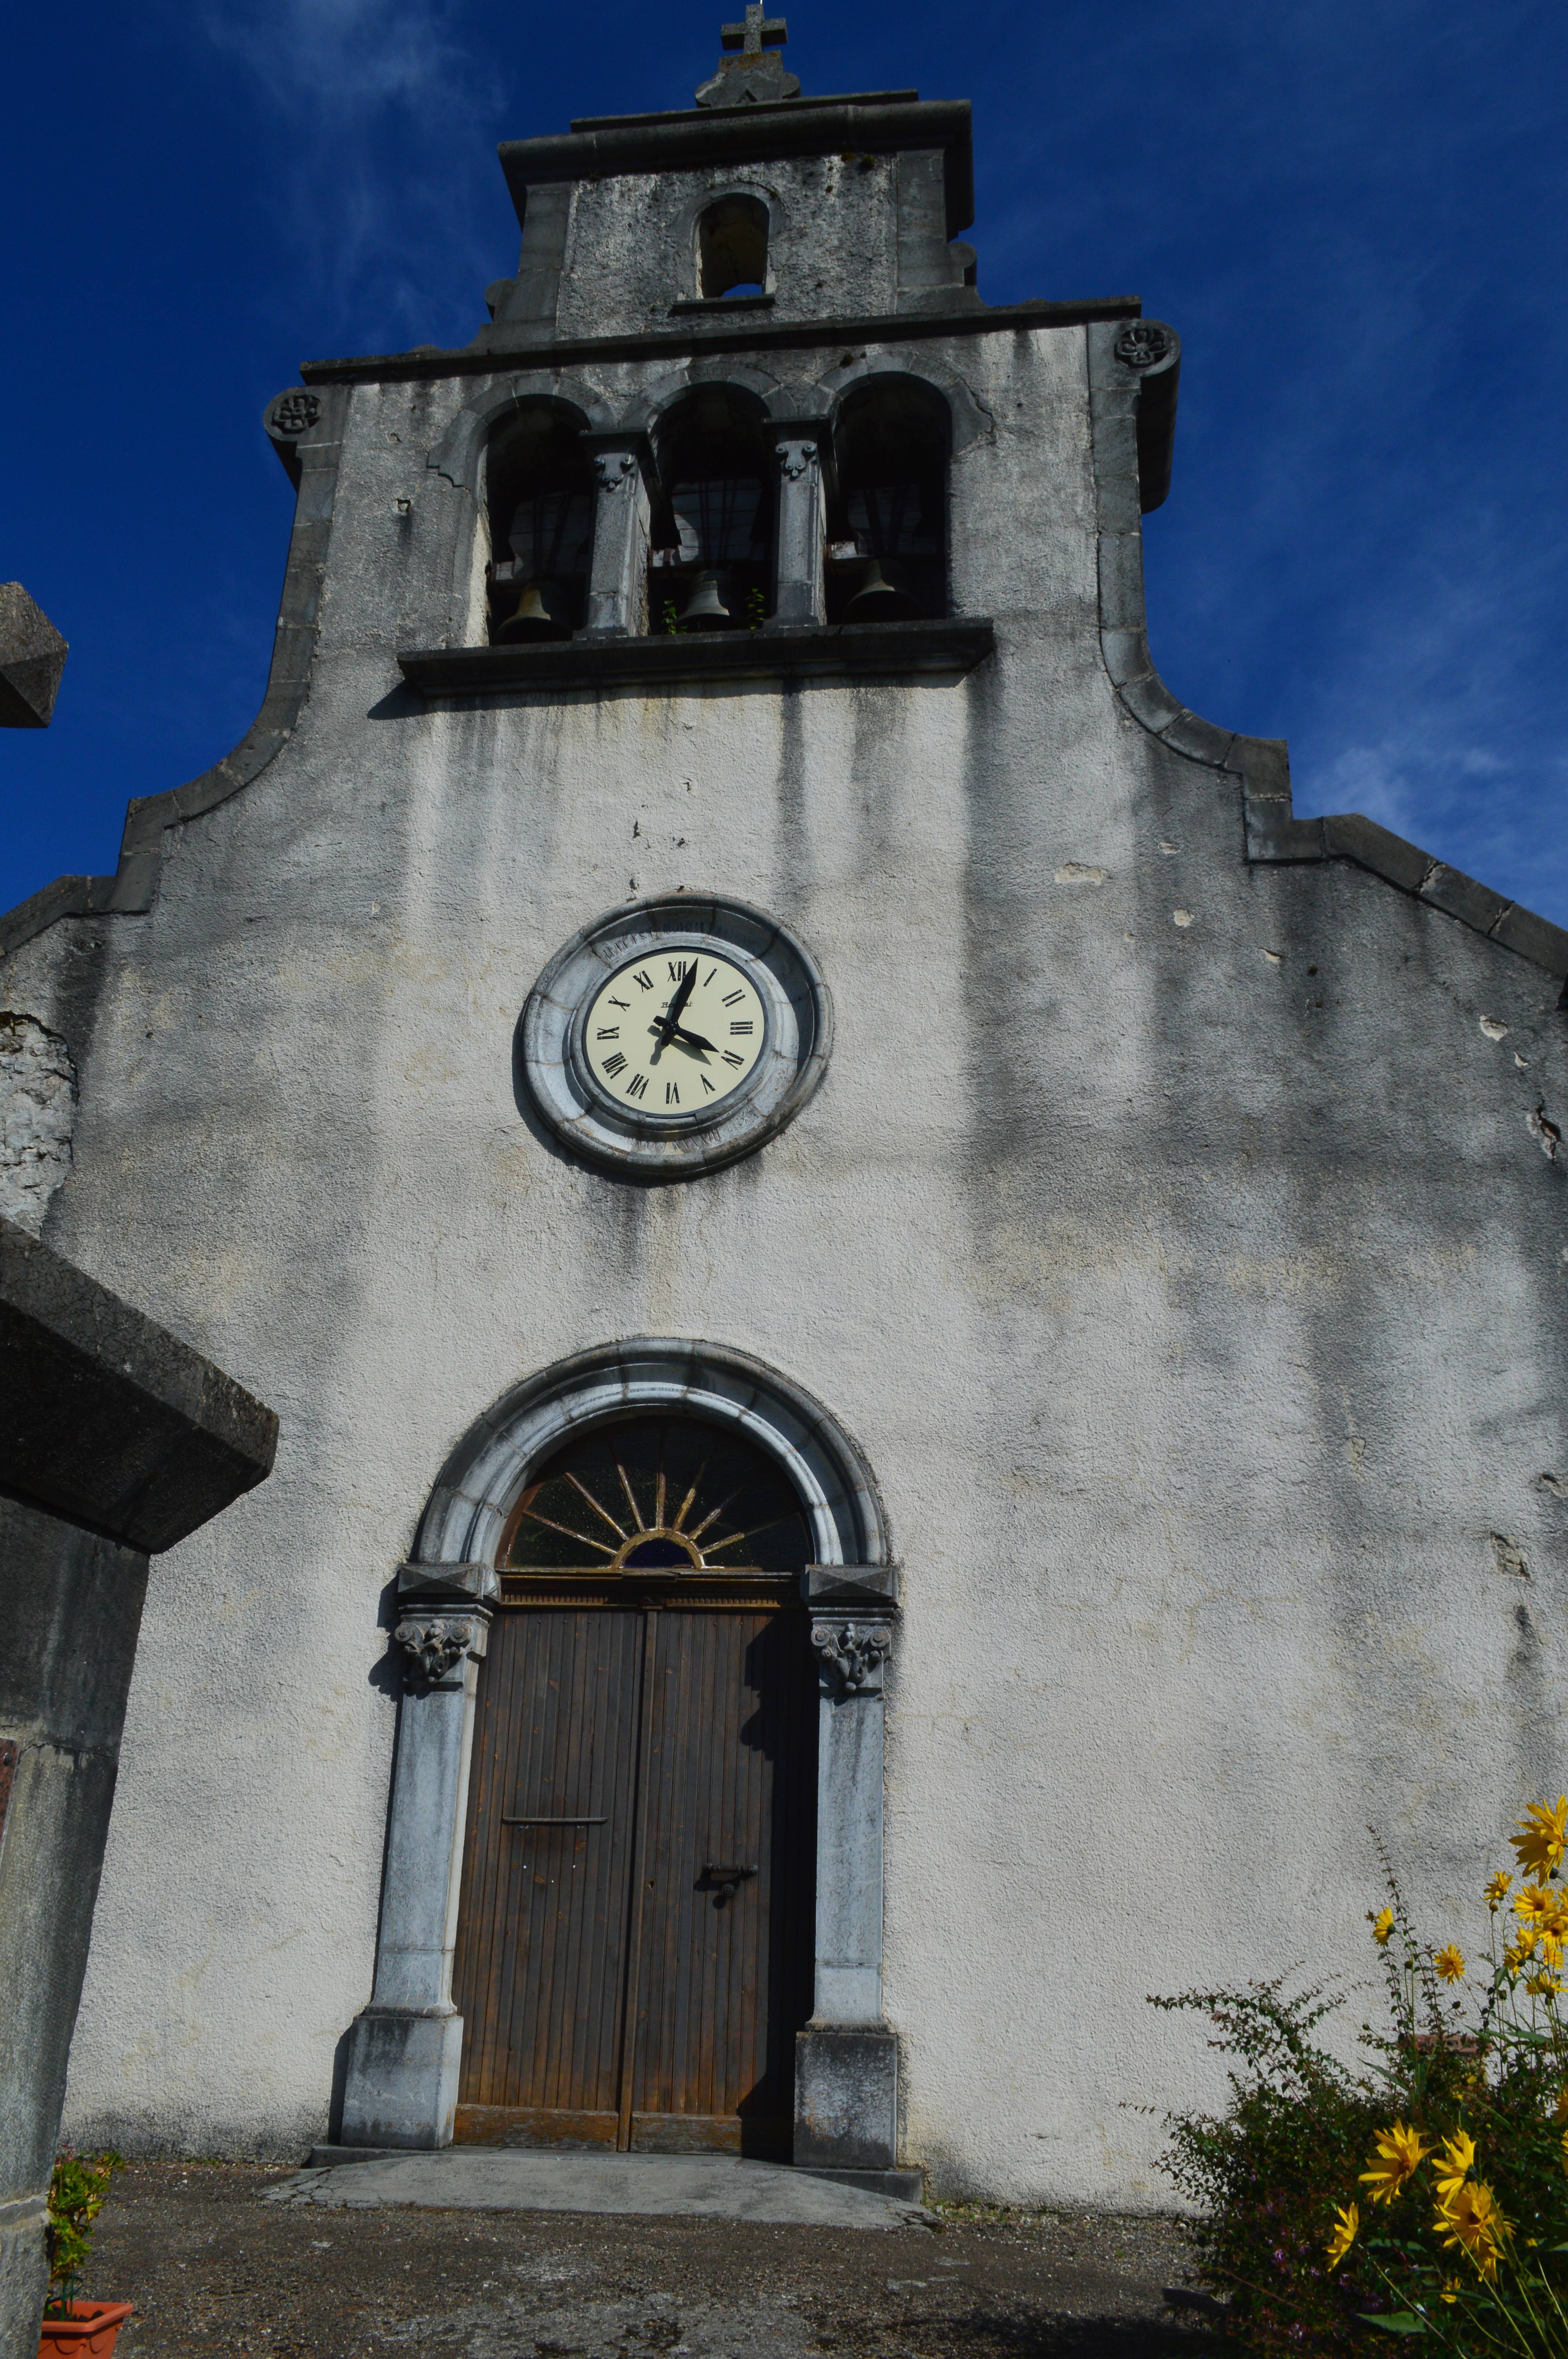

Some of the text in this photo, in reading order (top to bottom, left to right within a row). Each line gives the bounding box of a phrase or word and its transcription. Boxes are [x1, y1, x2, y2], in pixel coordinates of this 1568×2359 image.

[668, 961, 687, 981] XII
[703, 968, 717, 987] I
[632, 970, 654, 993] XI
[608, 996, 631, 1012] X
[722, 989, 746, 1007] II
[597, 1026, 620, 1040] IX
[730, 1021, 753, 1035] III
[601, 1052, 629, 1080] VIII
[720, 1050, 745, 1070] IV
[625, 1073, 649, 1100] VII
[666, 1082, 680, 1104] VI
[700, 1074, 716, 1094] V
